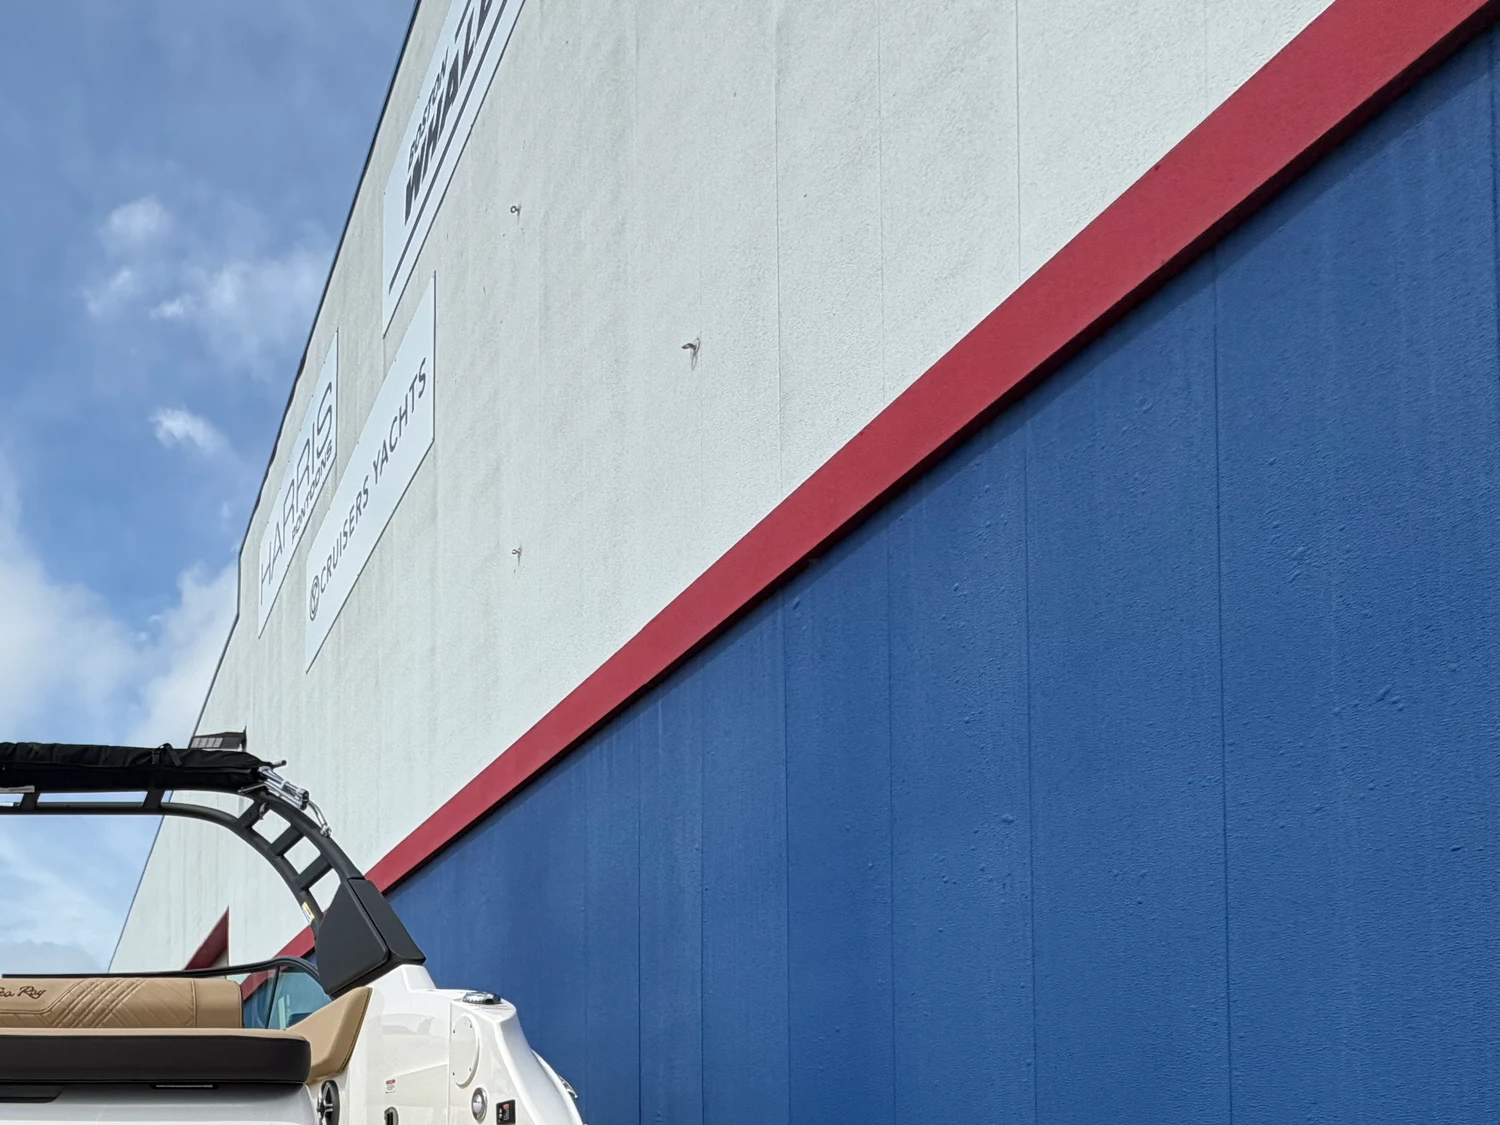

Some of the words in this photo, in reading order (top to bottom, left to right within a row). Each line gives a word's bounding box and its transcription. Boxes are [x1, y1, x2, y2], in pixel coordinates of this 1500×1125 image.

[407, 46, 449, 174] BOSTON
[260, 381, 333, 606] HARRIS
[291, 438, 333, 546] PONTOONS
[320, 475, 369, 594] CRUISERS
[372, 356, 427, 486] YACHTS
[17, 985, 47, 1000] Ray
